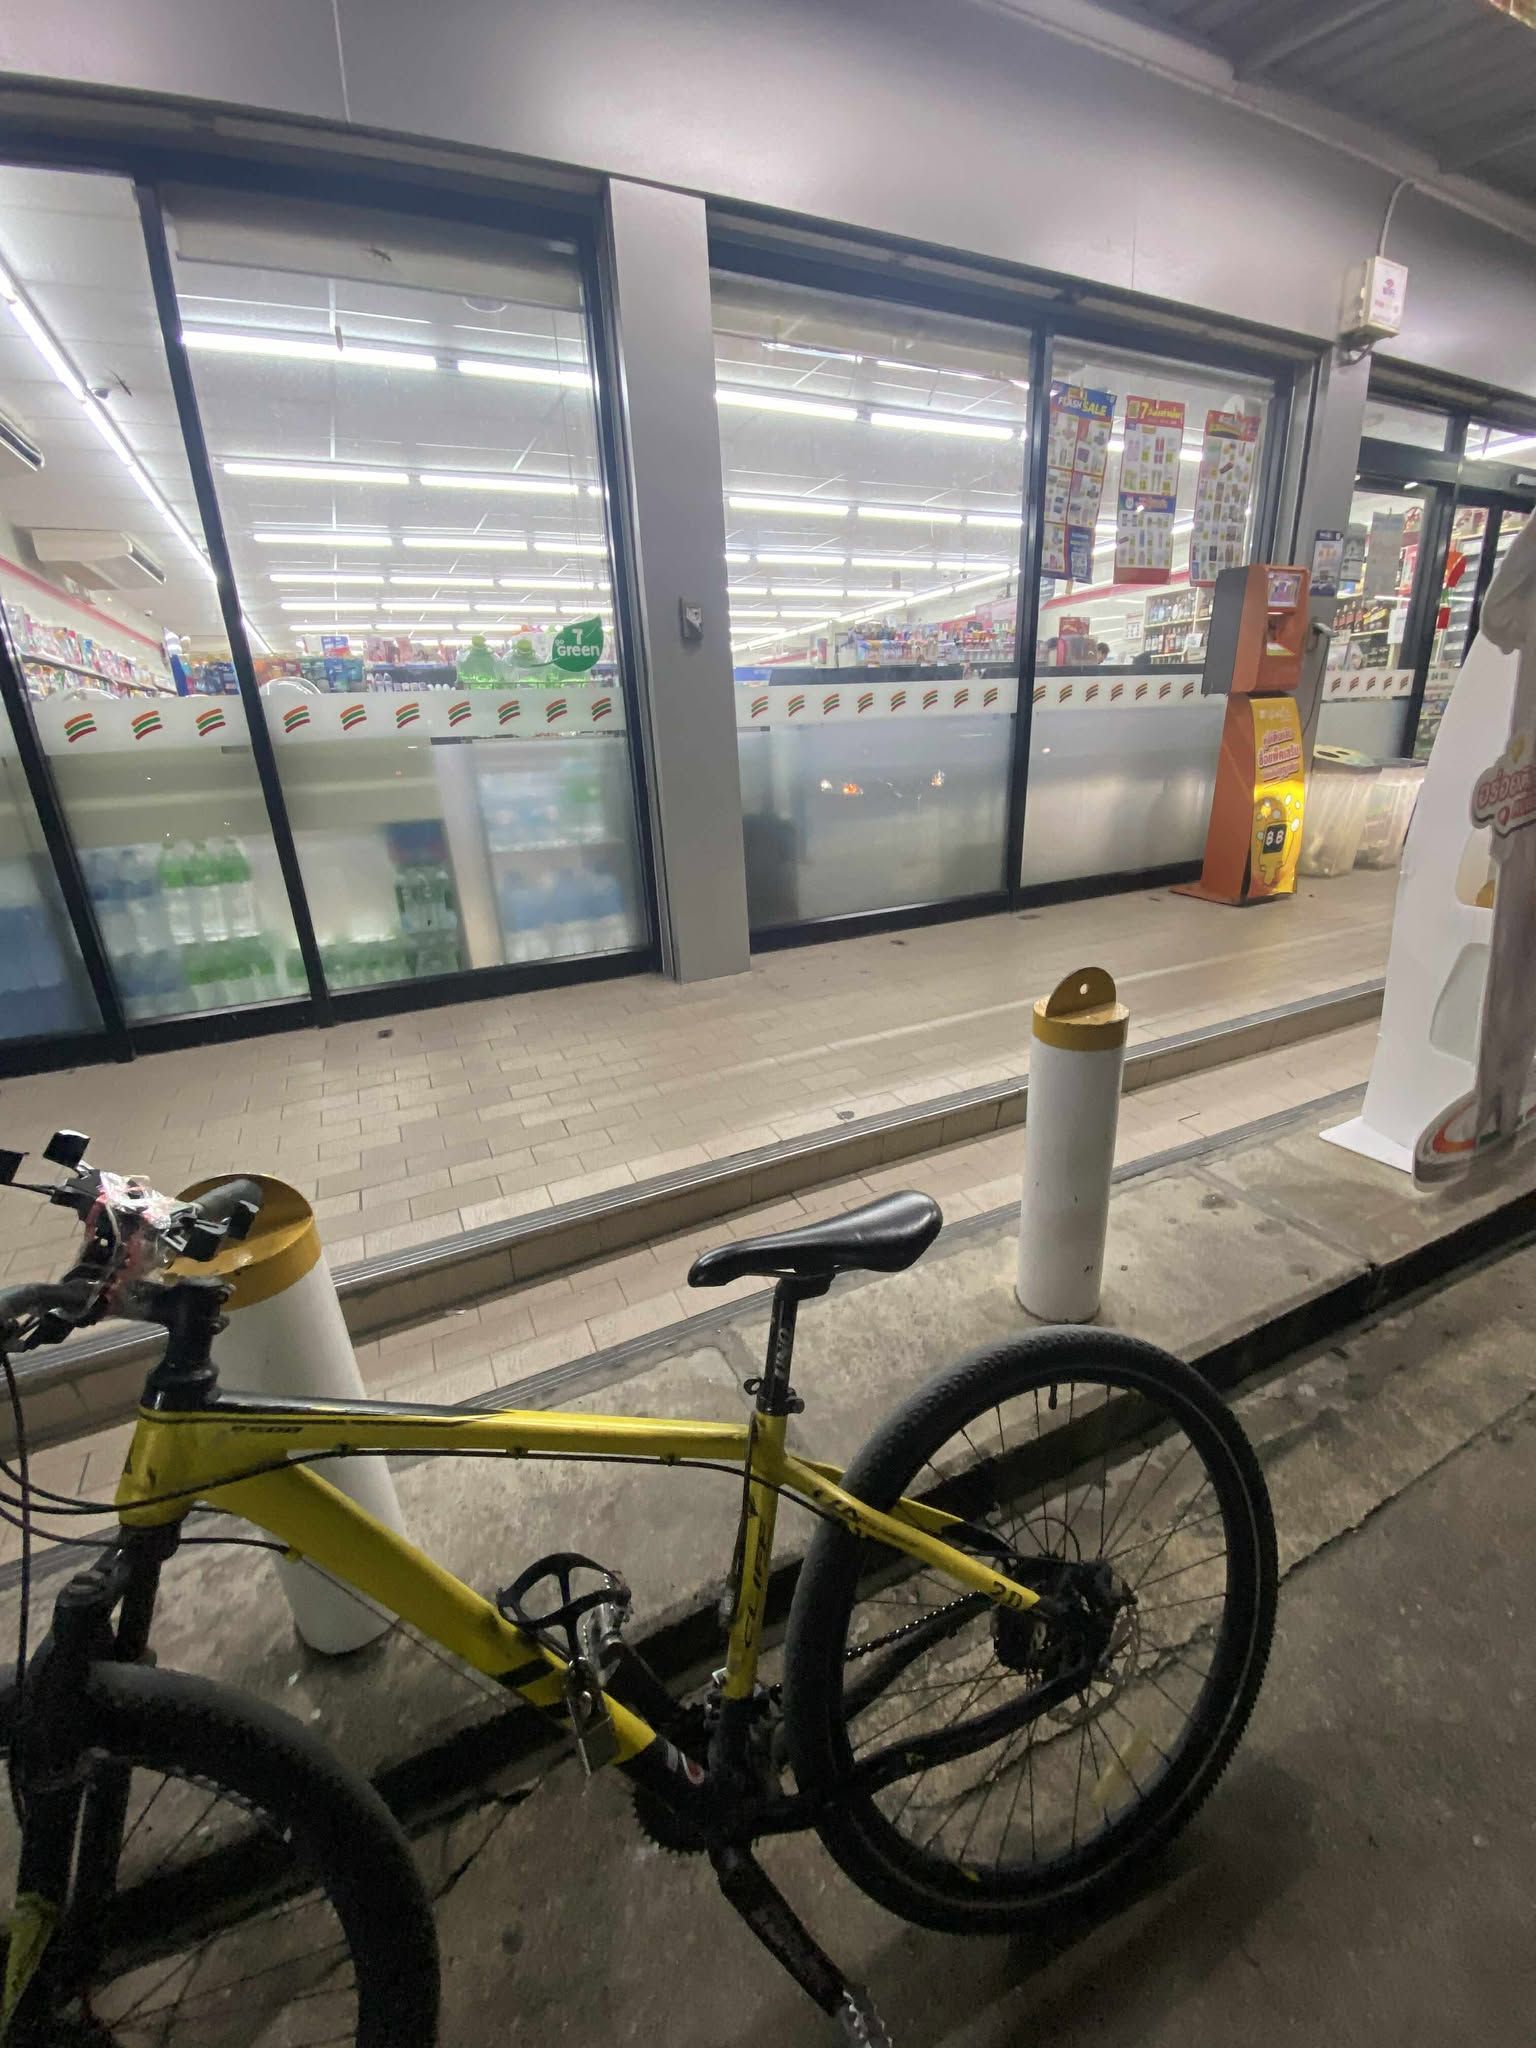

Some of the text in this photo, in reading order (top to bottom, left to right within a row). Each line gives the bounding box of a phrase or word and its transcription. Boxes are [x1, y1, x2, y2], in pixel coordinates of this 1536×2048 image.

[1082, 400, 1108, 416] SALE
[572, 628, 584, 645] 7
[557, 645, 600, 657] Green
